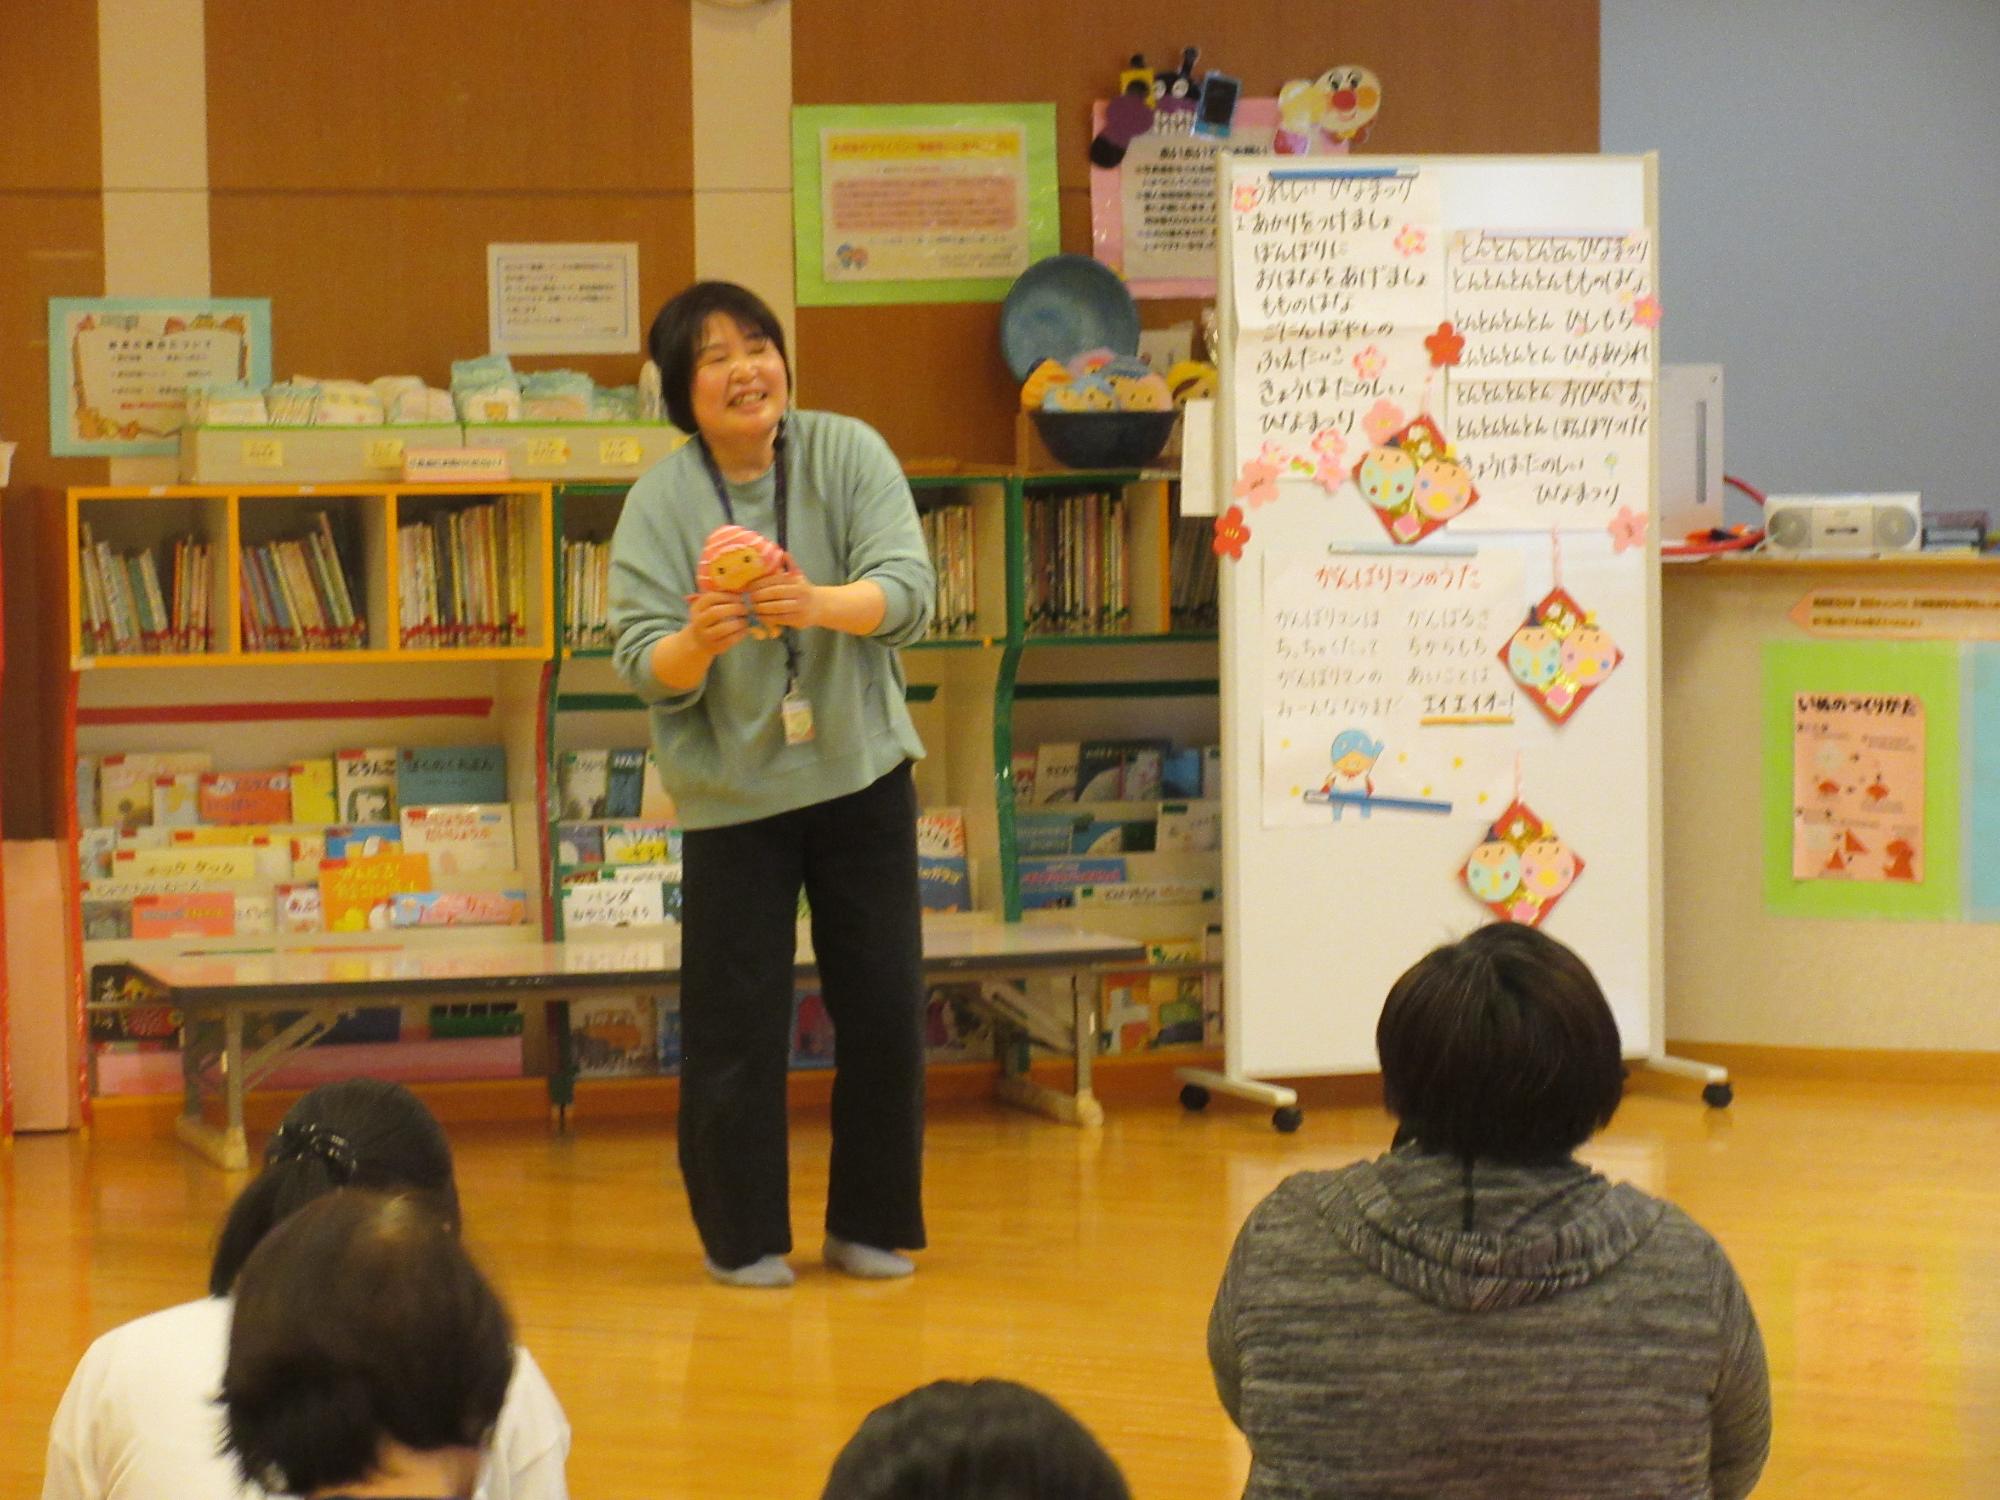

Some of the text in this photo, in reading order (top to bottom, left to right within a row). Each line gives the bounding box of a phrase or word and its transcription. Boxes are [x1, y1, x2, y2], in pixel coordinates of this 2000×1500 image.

[1253, 240, 1348, 263] ぼんぼりに
[1261, 292, 1352, 319] もものはな
[1314, 563, 1482, 592] がんばりマンのうた
